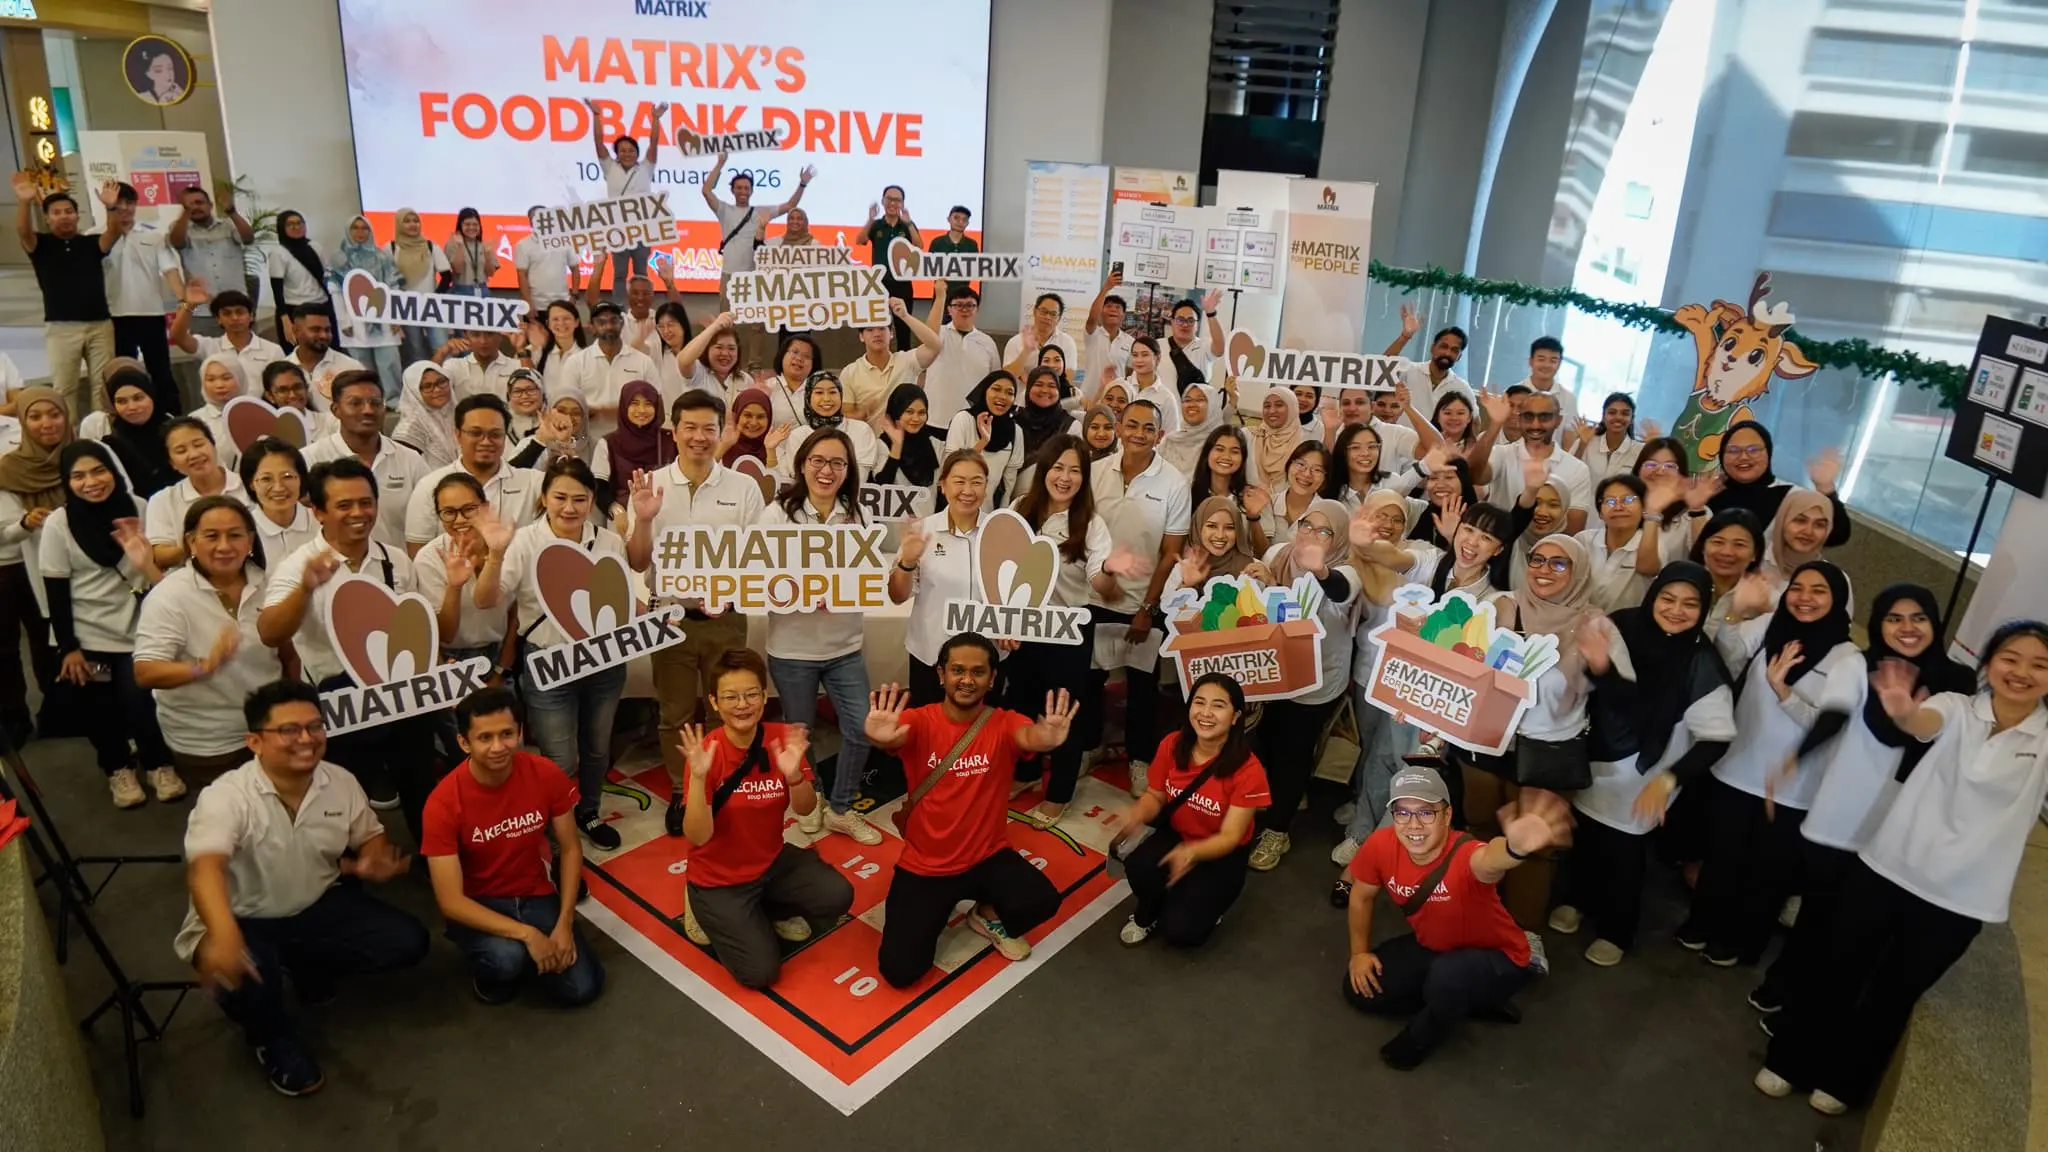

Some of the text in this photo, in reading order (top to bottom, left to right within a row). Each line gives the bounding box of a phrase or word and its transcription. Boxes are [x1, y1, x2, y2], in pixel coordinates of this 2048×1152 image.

[635, 0, 708, 18] MATRIX
[703, 130, 780, 155] MATRIX
[762, 106, 923, 157] DRIVE
[536, 193, 672, 236] #MATRIX
[543, 220, 677, 254] FOR PEOPLE
[1291, 240, 1360, 261] #MATRIX
[757, 247, 850, 265] #MATRIX
[923, 256, 1018, 278] MATRIX
[1041, 254, 1097, 269] MAWAR
[1304, 257, 1360, 275] PEOPLE
[731, 269, 884, 303] #MATRIX
[390, 295, 519, 328] MATRIX
[735, 300, 887, 328] FOR PEOPLE
[1268, 353, 1399, 387] MATRIX
[658, 530, 883, 569] #MATRIX
[662, 574, 884, 607] FOR PEOPLE
[947, 603, 1079, 640] MATRIX
[533, 612, 679, 686] MATRIX
[1190, 651, 1277, 675] #MATRIX
[322, 664, 481, 731] MATRIX
[1383, 676, 1469, 723] FOR PEOPLE
[1386, 660, 1474, 708] #MATRIX
[484, 810, 544, 841] KECHARA
[842, 855, 880, 879] 12
[833, 966, 878, 996] 10
